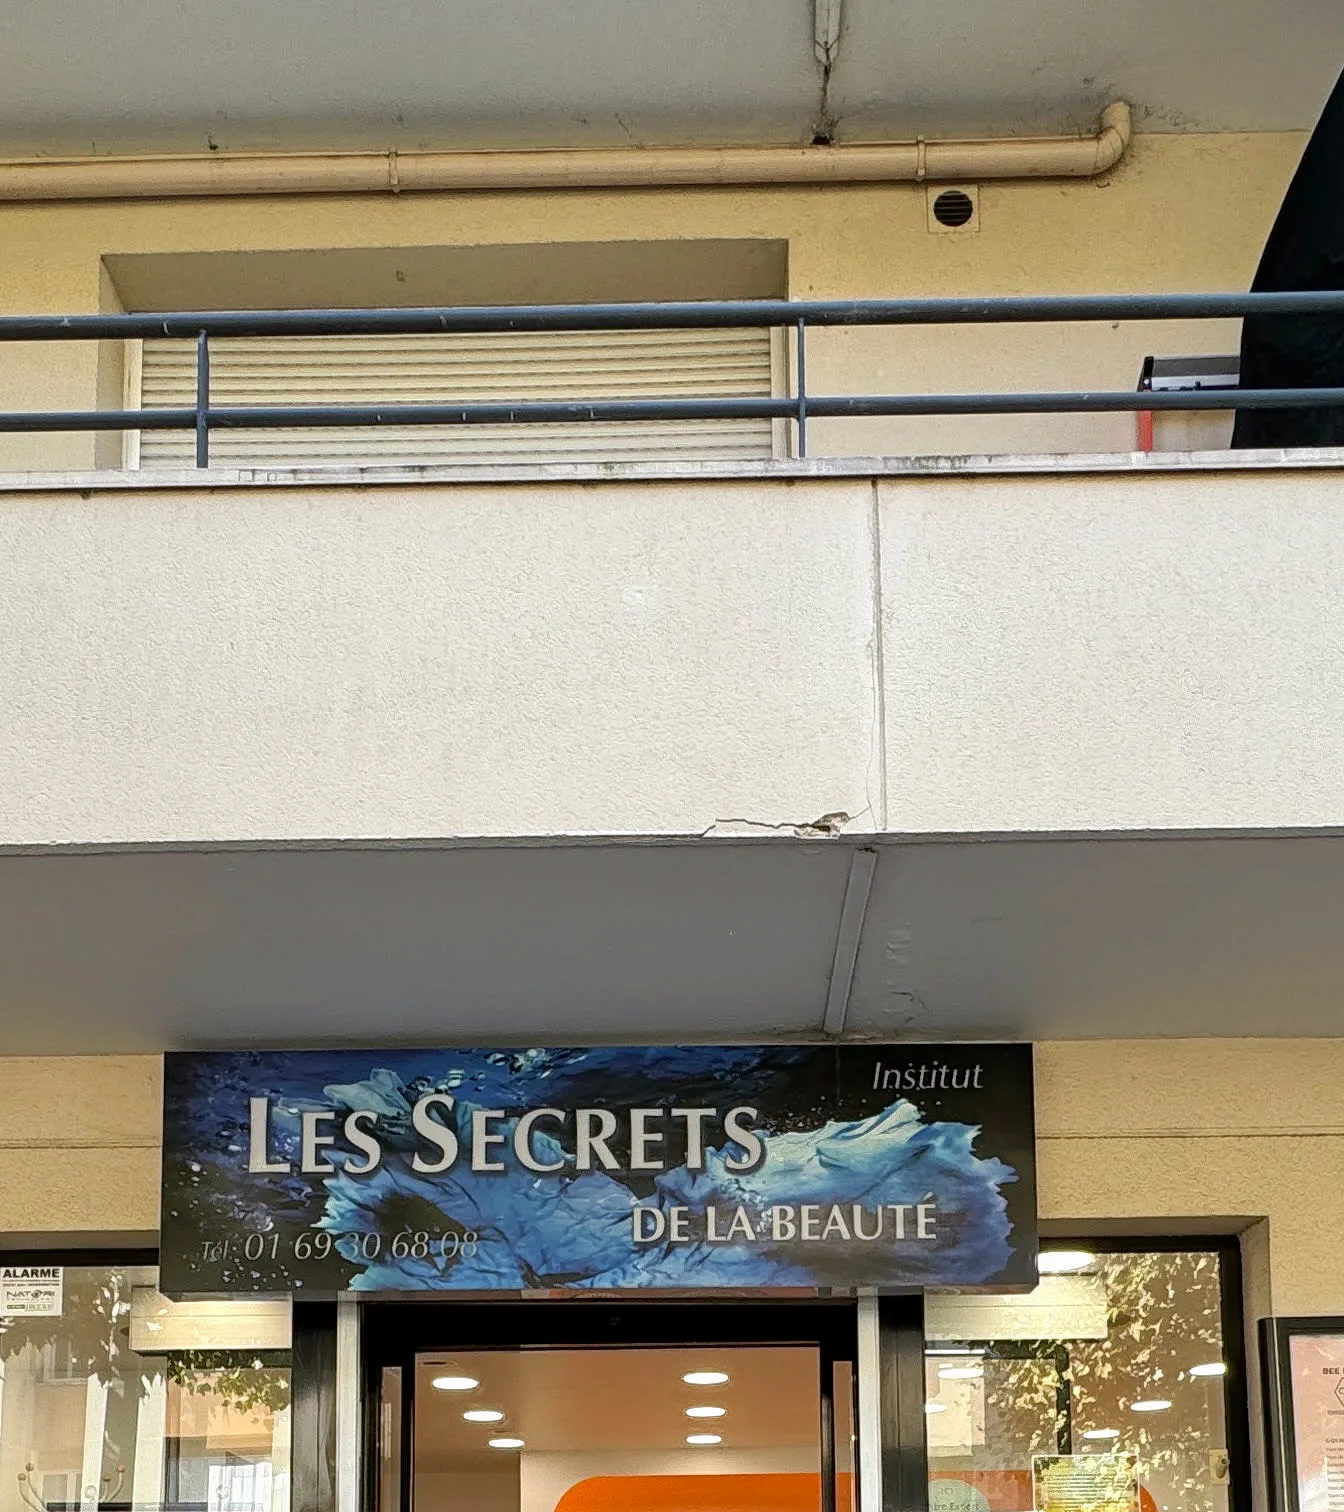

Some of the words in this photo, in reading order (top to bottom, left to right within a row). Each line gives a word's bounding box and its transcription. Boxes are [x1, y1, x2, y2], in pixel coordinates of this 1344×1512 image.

[872, 1060, 984, 1091] Institut
[247, 1096, 382, 1176] LES
[411, 1092, 767, 1175] SECRETS
[633, 1206, 689, 1244] DE
[706, 1205, 758, 1243] LA
[769, 1192, 937, 1242] BEAUTÉ
[244, 1232, 281, 1261] 01
[293, 1232, 333, 1260] 69
[345, 1231, 382, 1260] 30
[391, 1230, 430, 1260] 68
[440, 1230, 479, 1259] 08
[2, 1268, 60, 1279] ALARME
[1322, 1366, 1340, 1375] BEE
